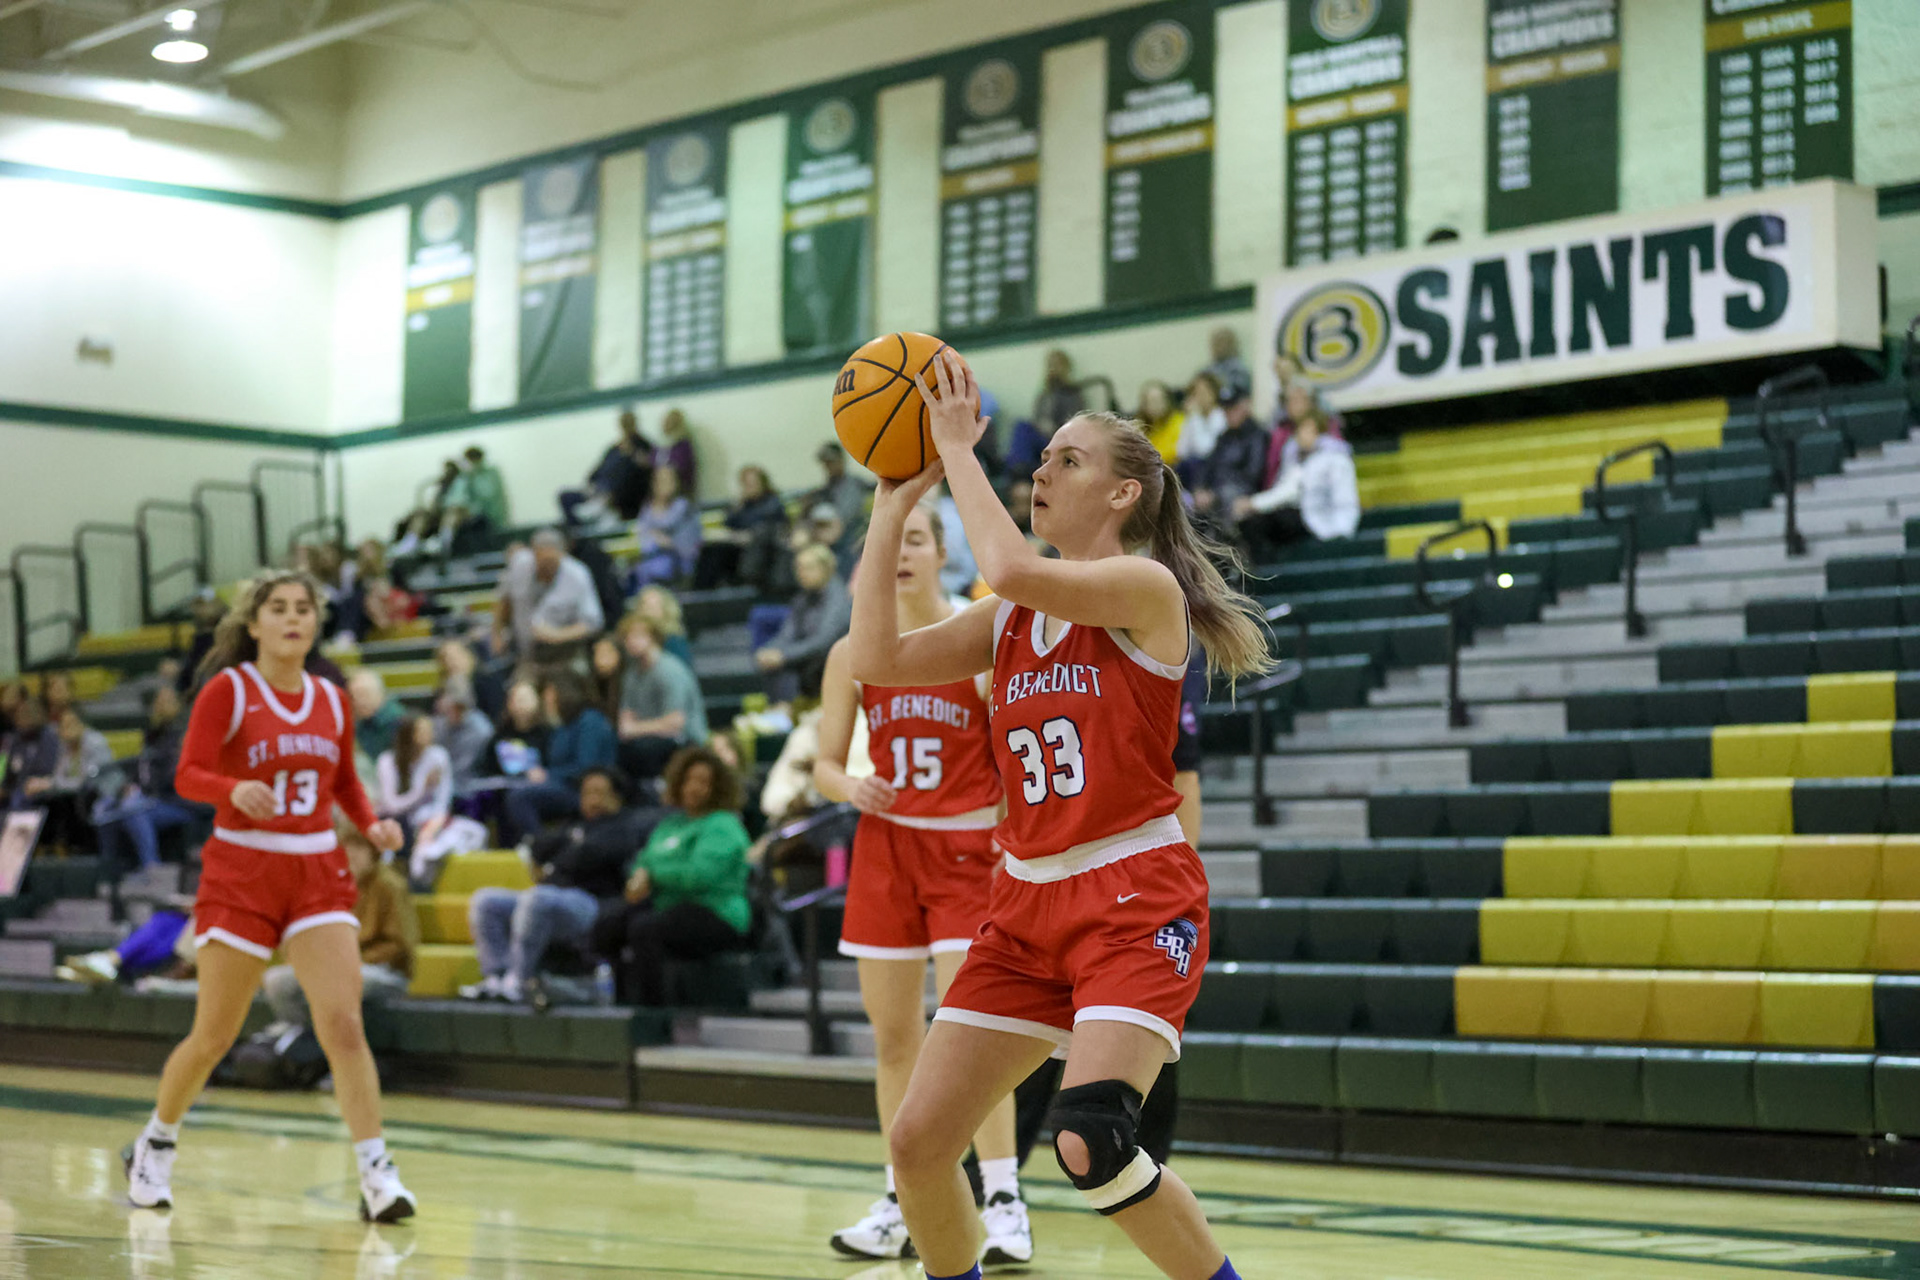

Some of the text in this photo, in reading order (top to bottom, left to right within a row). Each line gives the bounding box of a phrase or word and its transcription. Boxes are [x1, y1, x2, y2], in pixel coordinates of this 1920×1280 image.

[1397, 213, 1790, 378] SAINTS
[1006, 662, 1102, 705] BENEDICT
[869, 694, 971, 732] ST. BENEDICT
[891, 736, 943, 790] 15
[1006, 715, 1087, 806] 33
[273, 769, 319, 817] 13
[1155, 926, 1191, 976] SBA
